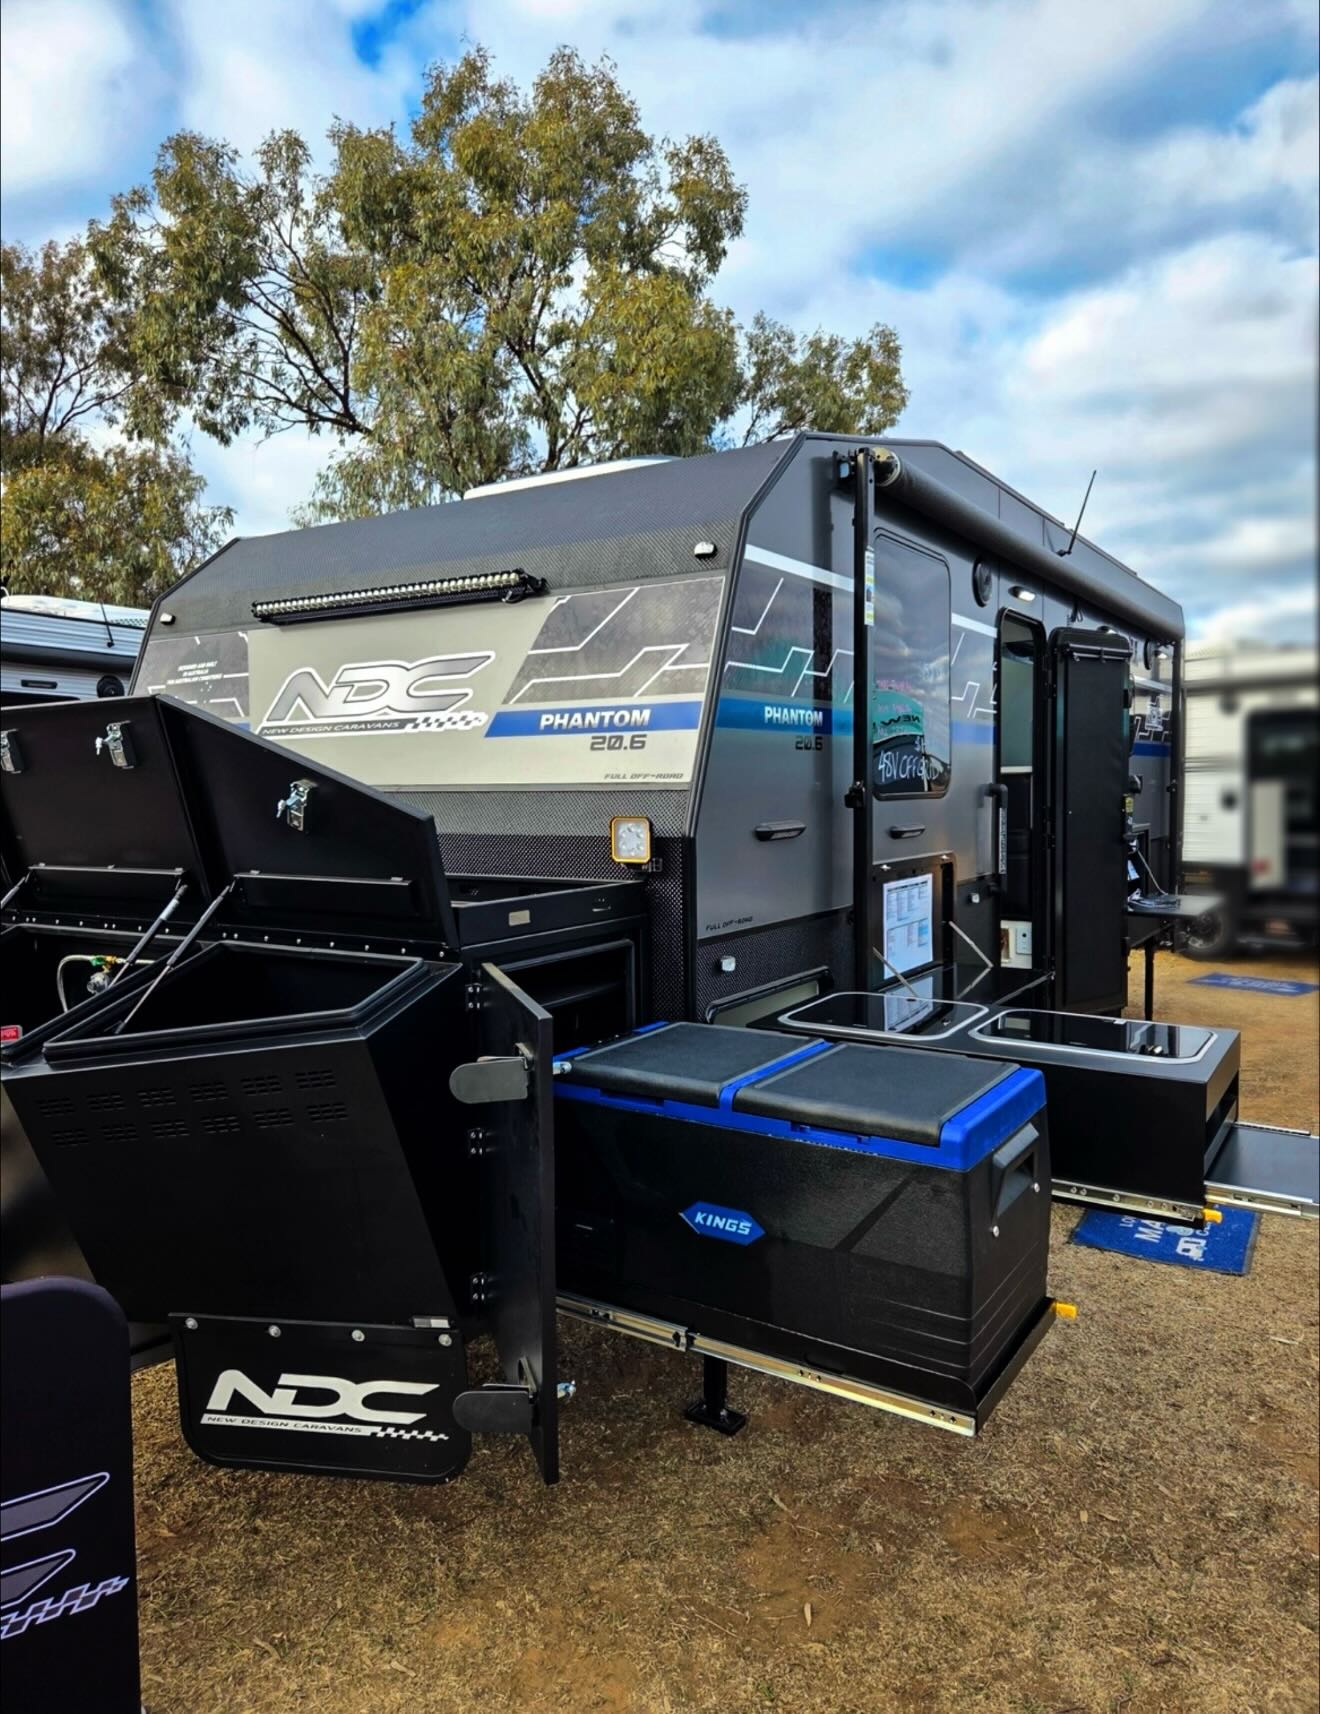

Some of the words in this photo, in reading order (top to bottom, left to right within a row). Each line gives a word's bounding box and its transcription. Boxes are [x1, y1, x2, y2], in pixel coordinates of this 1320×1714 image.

[264, 652, 494, 723] NDC
[540, 708, 652, 731] PHANTOM
[763, 705, 824, 727] PHANTOM
[261, 726, 289, 736] NEW
[289, 724, 332, 734] DESIGN
[333, 721, 401, 732] CARAVANS
[589, 733, 648, 752] 20.6
[795, 735, 824, 751] 20.6
[603, 772, 628, 781] FULL
[694, 1211, 753, 1236] KINGS
[205, 1369, 441, 1425] NDC
[206, 1415, 237, 1425] NEW
[241, 1417, 290, 1428] DESIGN
[293, 1423, 364, 1434] CARAVANS
